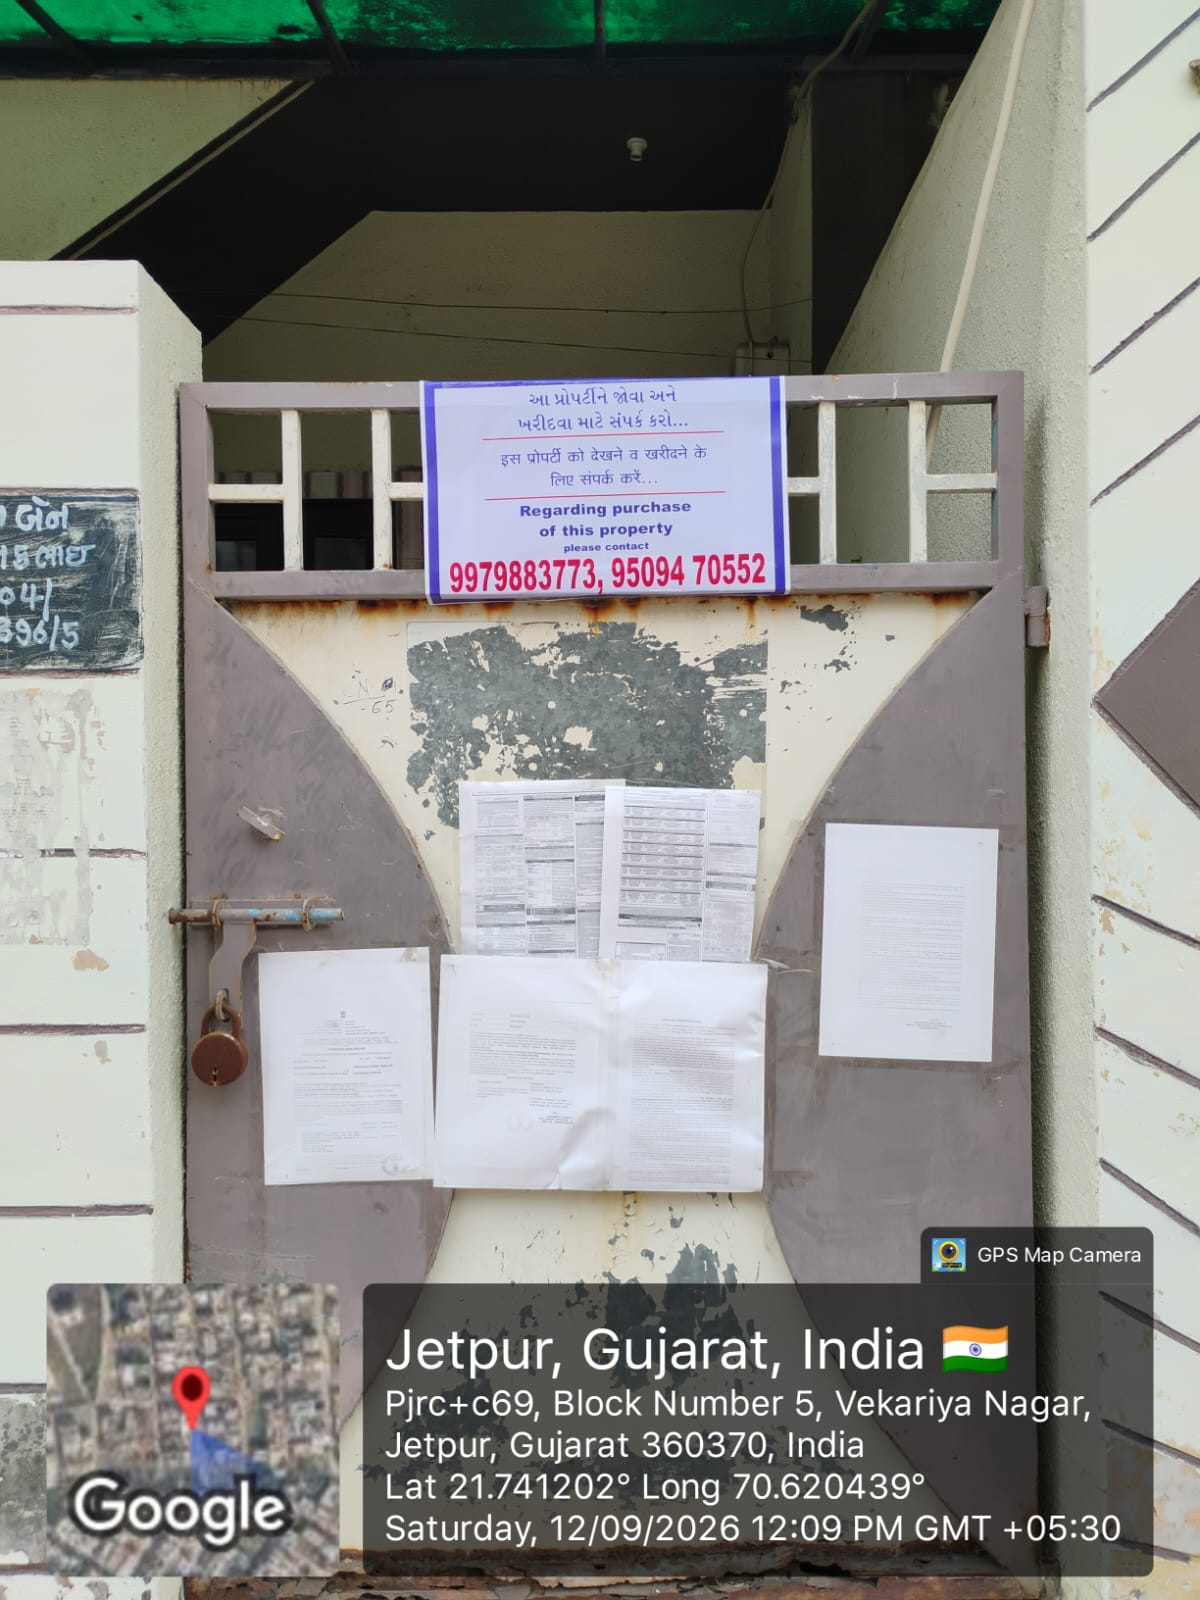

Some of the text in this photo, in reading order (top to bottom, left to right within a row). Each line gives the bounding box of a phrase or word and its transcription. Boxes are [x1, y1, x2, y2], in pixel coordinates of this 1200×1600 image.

[529, 385, 677, 406] આ પ્રોપર્ટીને જોવા અને
[518, 413, 572, 432] ખરીદવા
[578, 411, 604, 430] માટે
[610, 409, 643, 429] સંપર્ક
[500, 443, 708, 468] इस प्रोपर्टी को देखने व खरीदने के
[550, 471, 574, 487] लिए
[580, 469, 614, 486] संपर्क
[520, 501, 692, 519] Regarding purchase
[539, 522, 673, 538] of this property
[564, 542, 649, 553] please contact
[450, 553, 766, 594] 9979883773, 95094 70552
